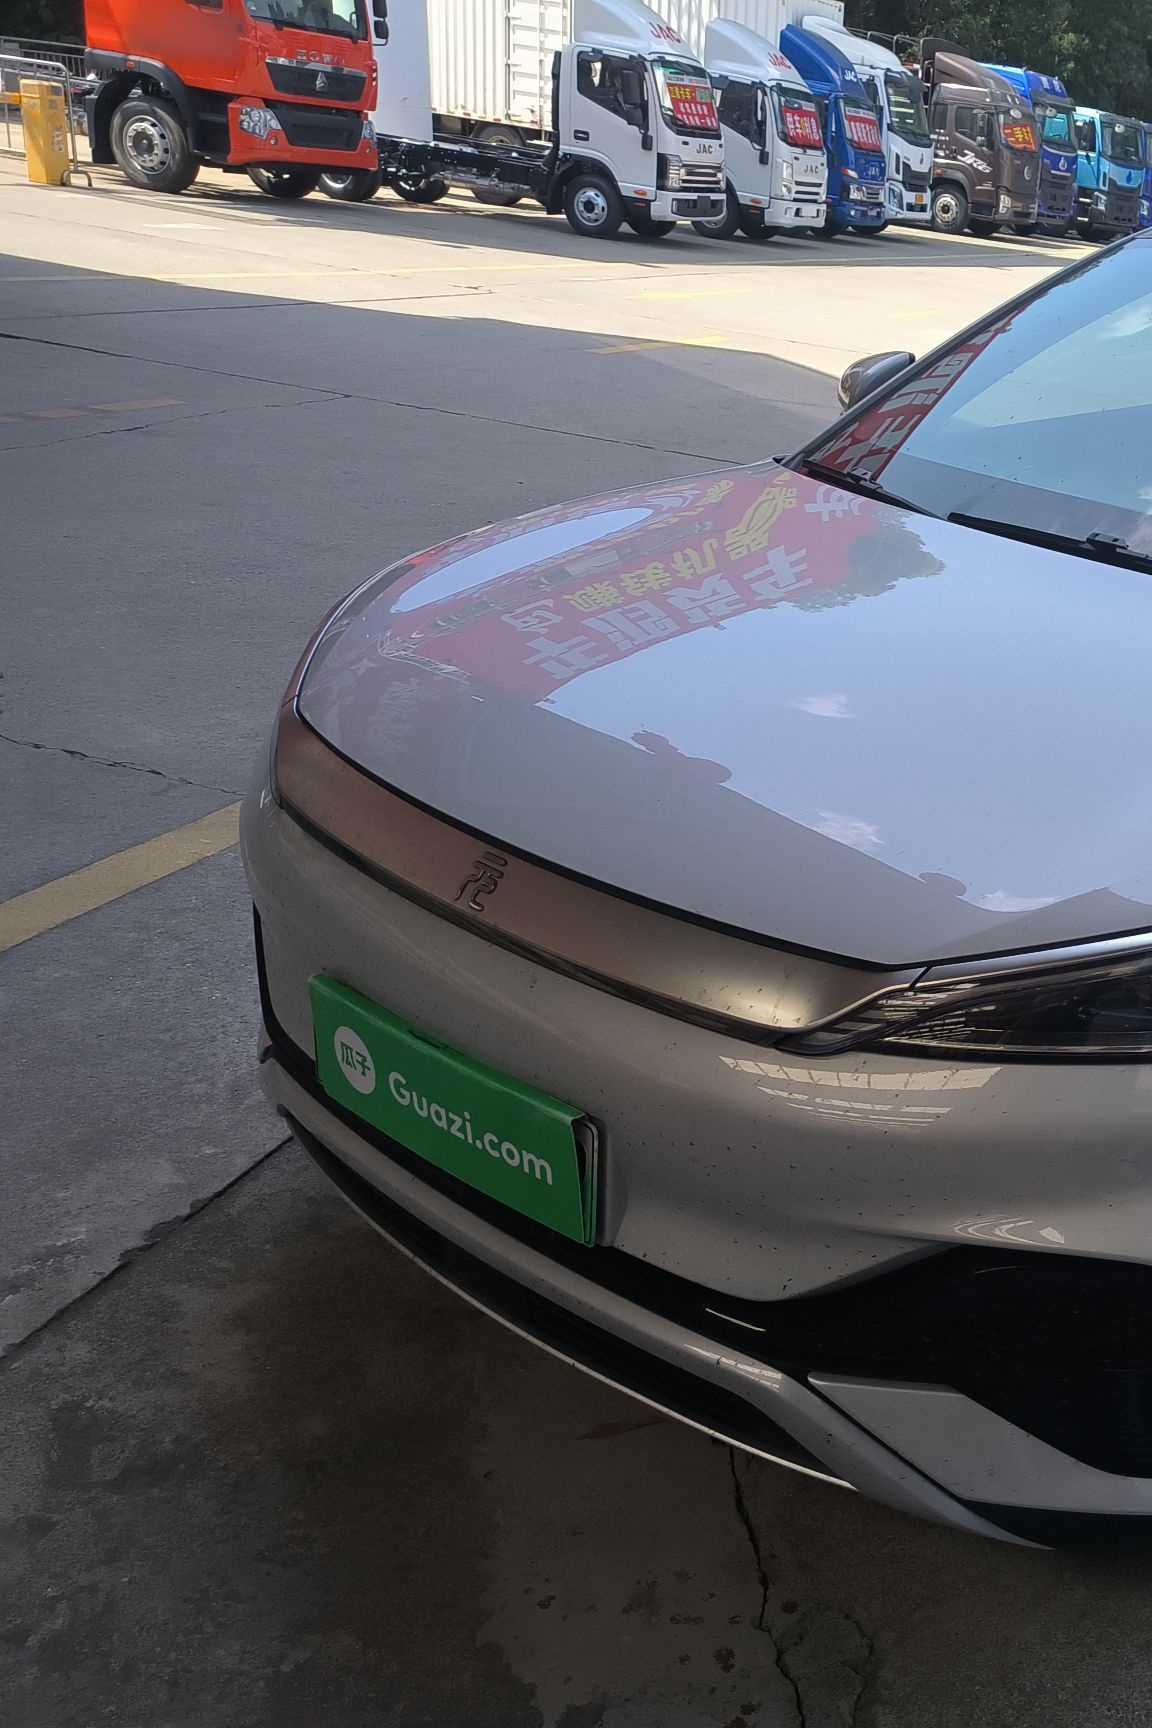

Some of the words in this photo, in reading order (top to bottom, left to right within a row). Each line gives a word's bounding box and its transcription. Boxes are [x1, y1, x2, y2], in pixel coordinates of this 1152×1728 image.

[649, 21, 682, 43] JAC
[768, 52, 791, 69] JAC
[844, 69, 857, 82] JAC
[696, 143, 713, 154] JAC
[803, 164, 819, 174] JAC
[867, 165, 880, 177] JAC
[339, 1040, 372, 1077] 瓜子
[388, 1070, 554, 1186] Guazi.com
